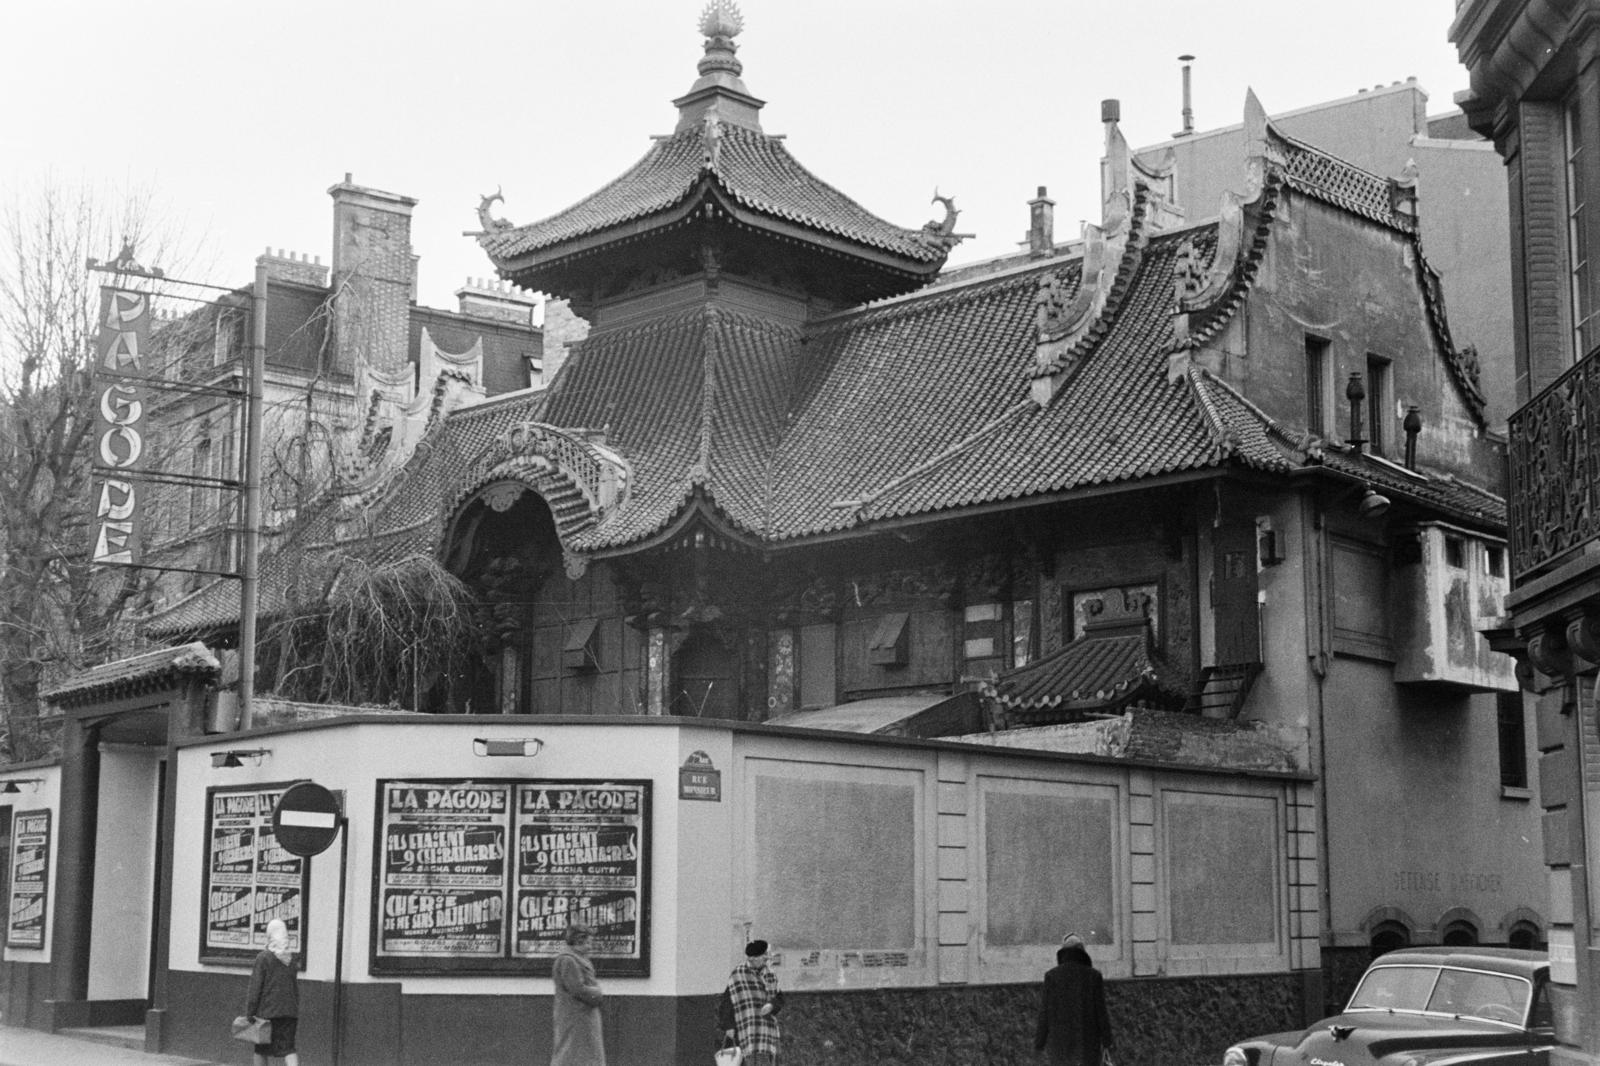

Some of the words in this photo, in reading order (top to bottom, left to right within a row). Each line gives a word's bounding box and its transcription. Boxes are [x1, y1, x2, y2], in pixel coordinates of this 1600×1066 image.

[93, 290, 146, 564] PAGODE
[391, 789, 418, 809] LA
[425, 789, 504, 809] PAGODE
[524, 789, 550, 809] LA
[557, 789, 637, 809] PAGODE
[403, 849, 415, 867] 9
[536, 851, 548, 868] 9
[587, 866, 621, 874] GUITRY
[384, 917, 395, 931] JE
[518, 919, 529, 932] JE
